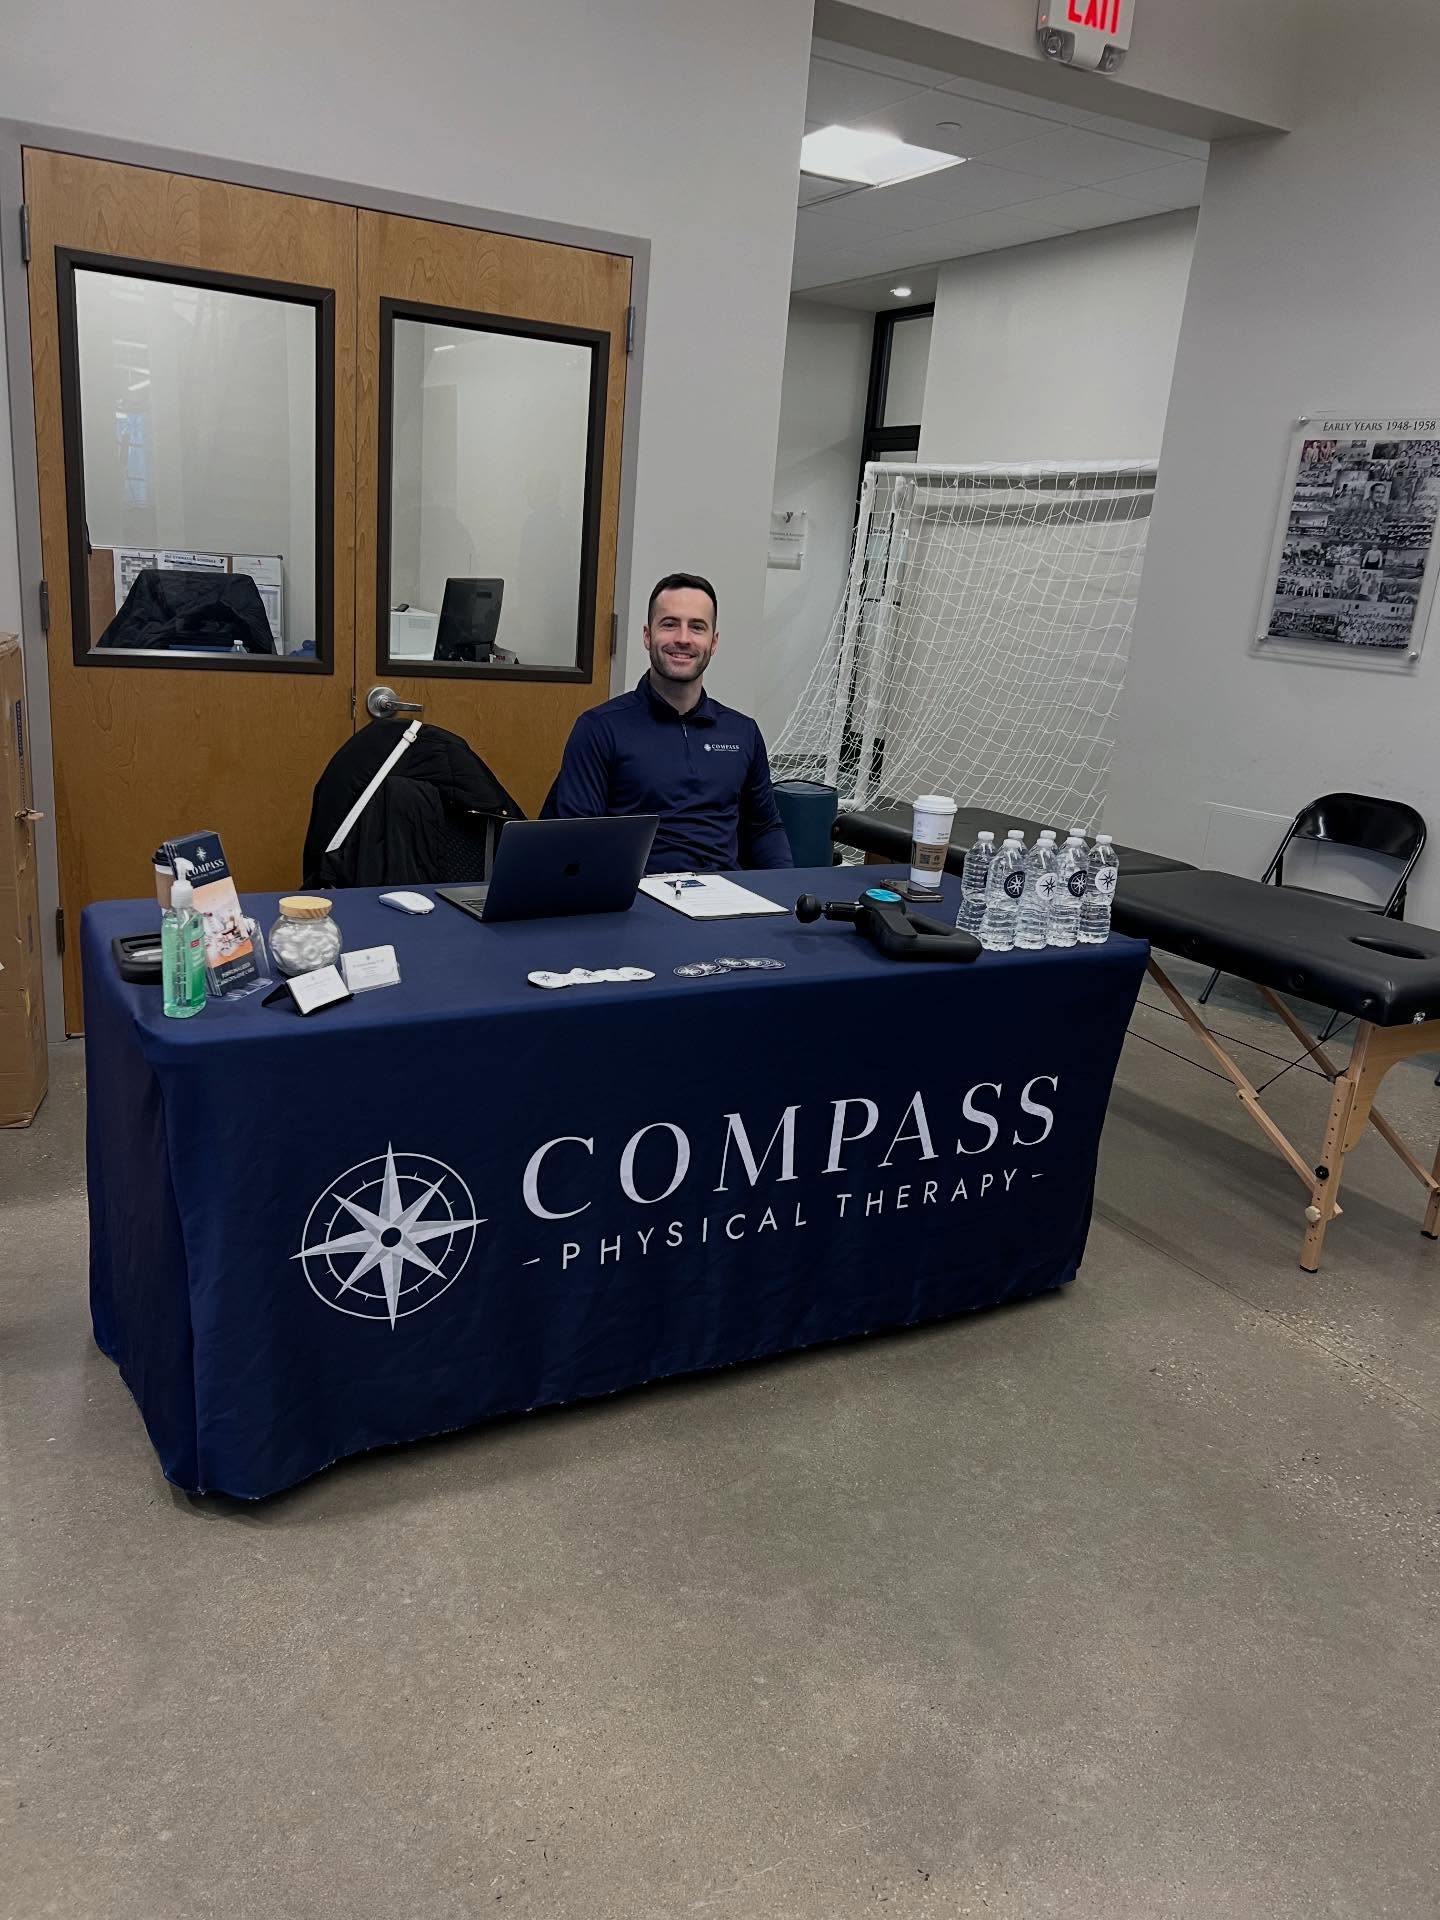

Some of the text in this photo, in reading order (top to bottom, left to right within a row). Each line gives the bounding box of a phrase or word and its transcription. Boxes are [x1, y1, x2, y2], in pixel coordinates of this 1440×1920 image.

[1323, 420, 1437, 431] EARLY YEARS 1948-1958
[522, 1075, 1059, 1220] COMPASS
[562, 1168, 1018, 1270] PHYSICAL THERAPY
